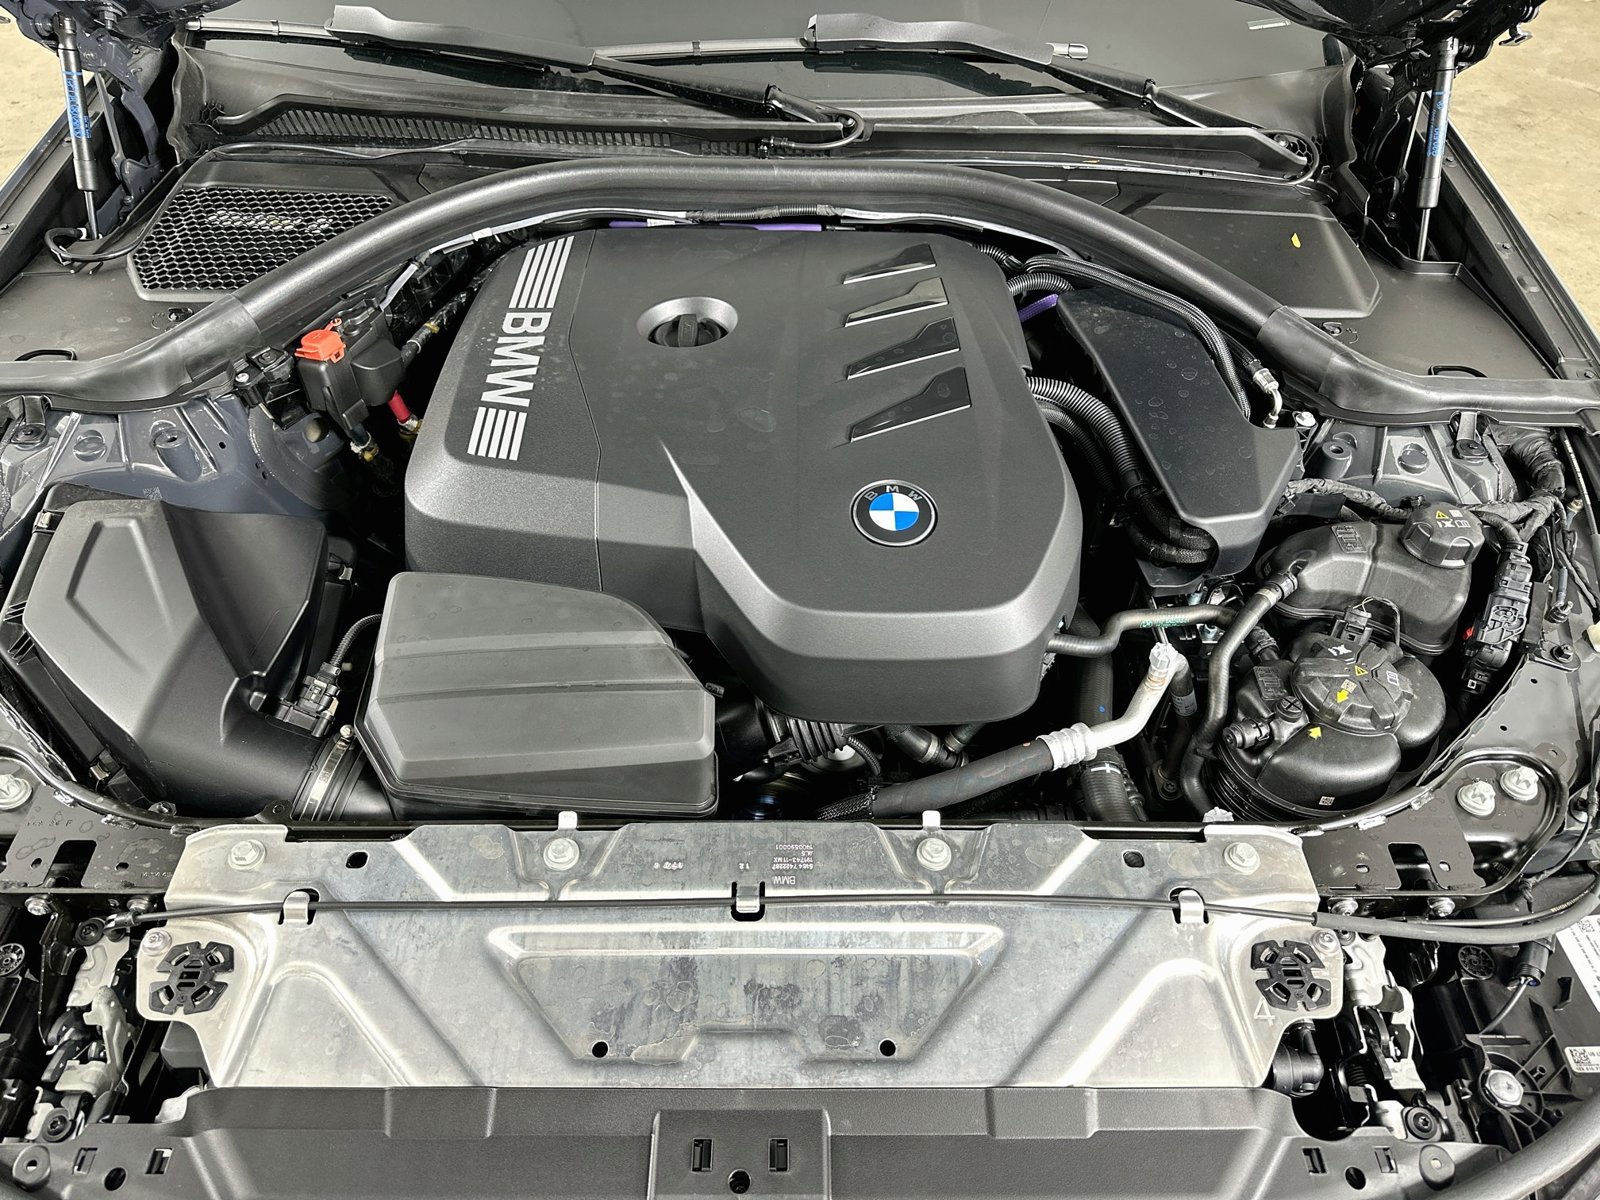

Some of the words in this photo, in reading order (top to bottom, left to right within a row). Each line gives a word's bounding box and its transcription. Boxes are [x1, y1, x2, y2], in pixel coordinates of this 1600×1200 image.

[481, 312, 551, 407] BMW
[864, 485, 923, 501] BMW
[773, 875, 796, 885] BMW
[1253, 995, 1276, 1026] 4
